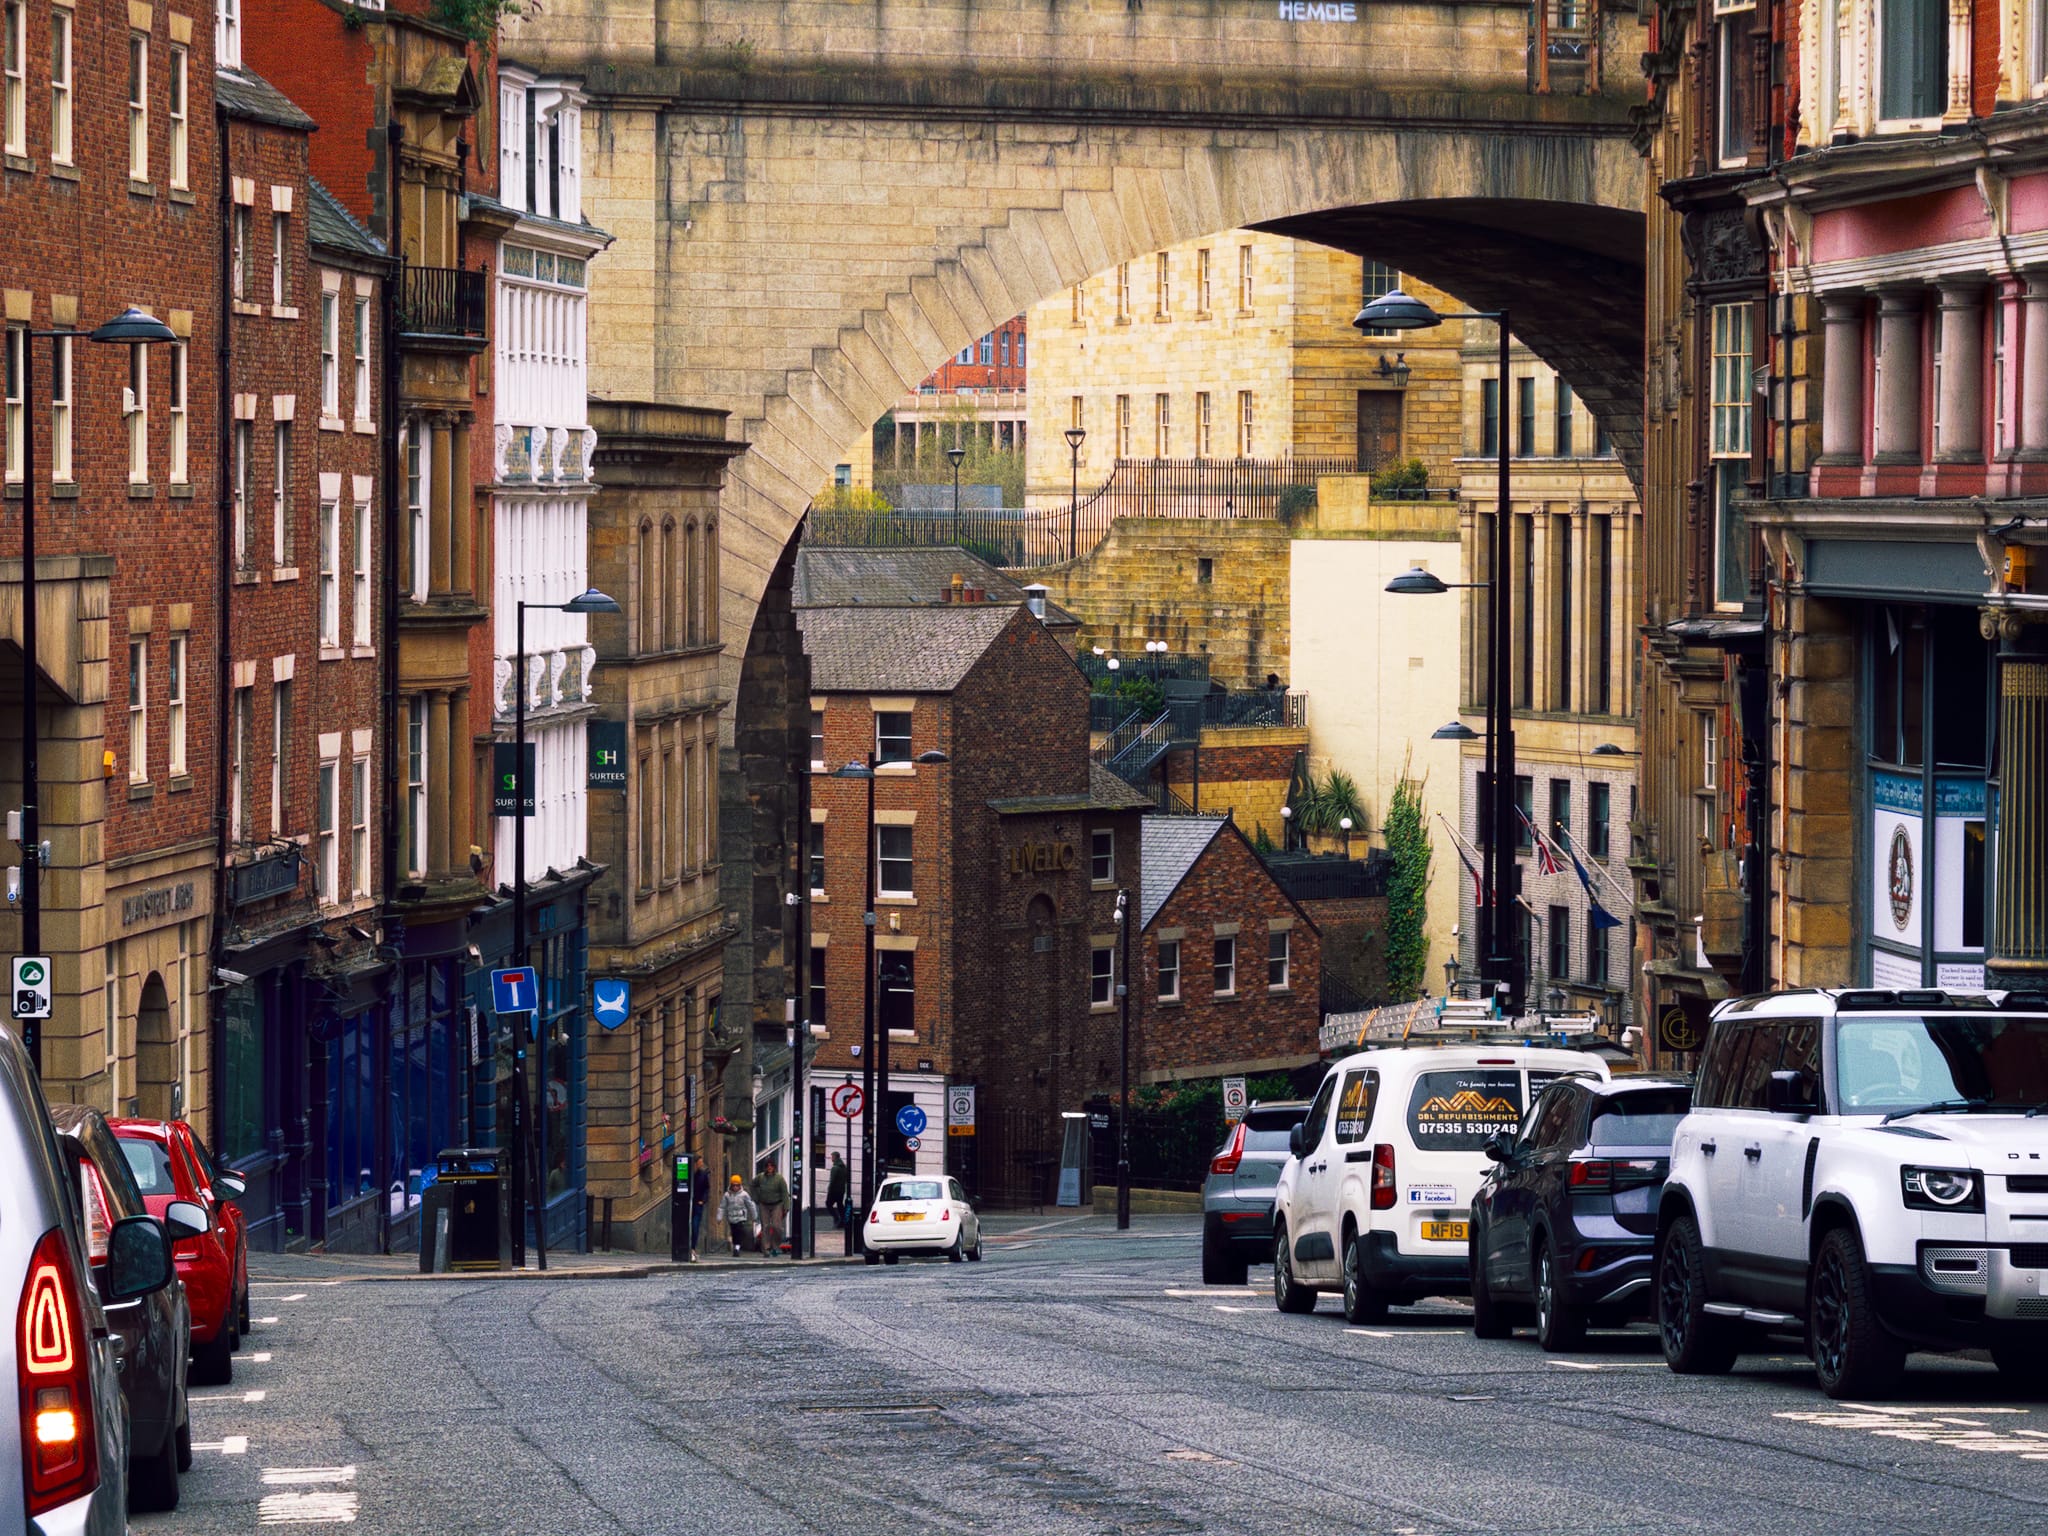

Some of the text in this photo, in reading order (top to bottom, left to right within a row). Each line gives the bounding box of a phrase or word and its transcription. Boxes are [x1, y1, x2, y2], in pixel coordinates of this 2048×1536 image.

[589, 772, 625, 780] SURTEES
[495, 799, 534, 807] SURTES
[1419, 1123, 1518, 1134] 07535 530248
[908, 1140, 919, 1148] 20
[1431, 1223, 1464, 1238] MF19
